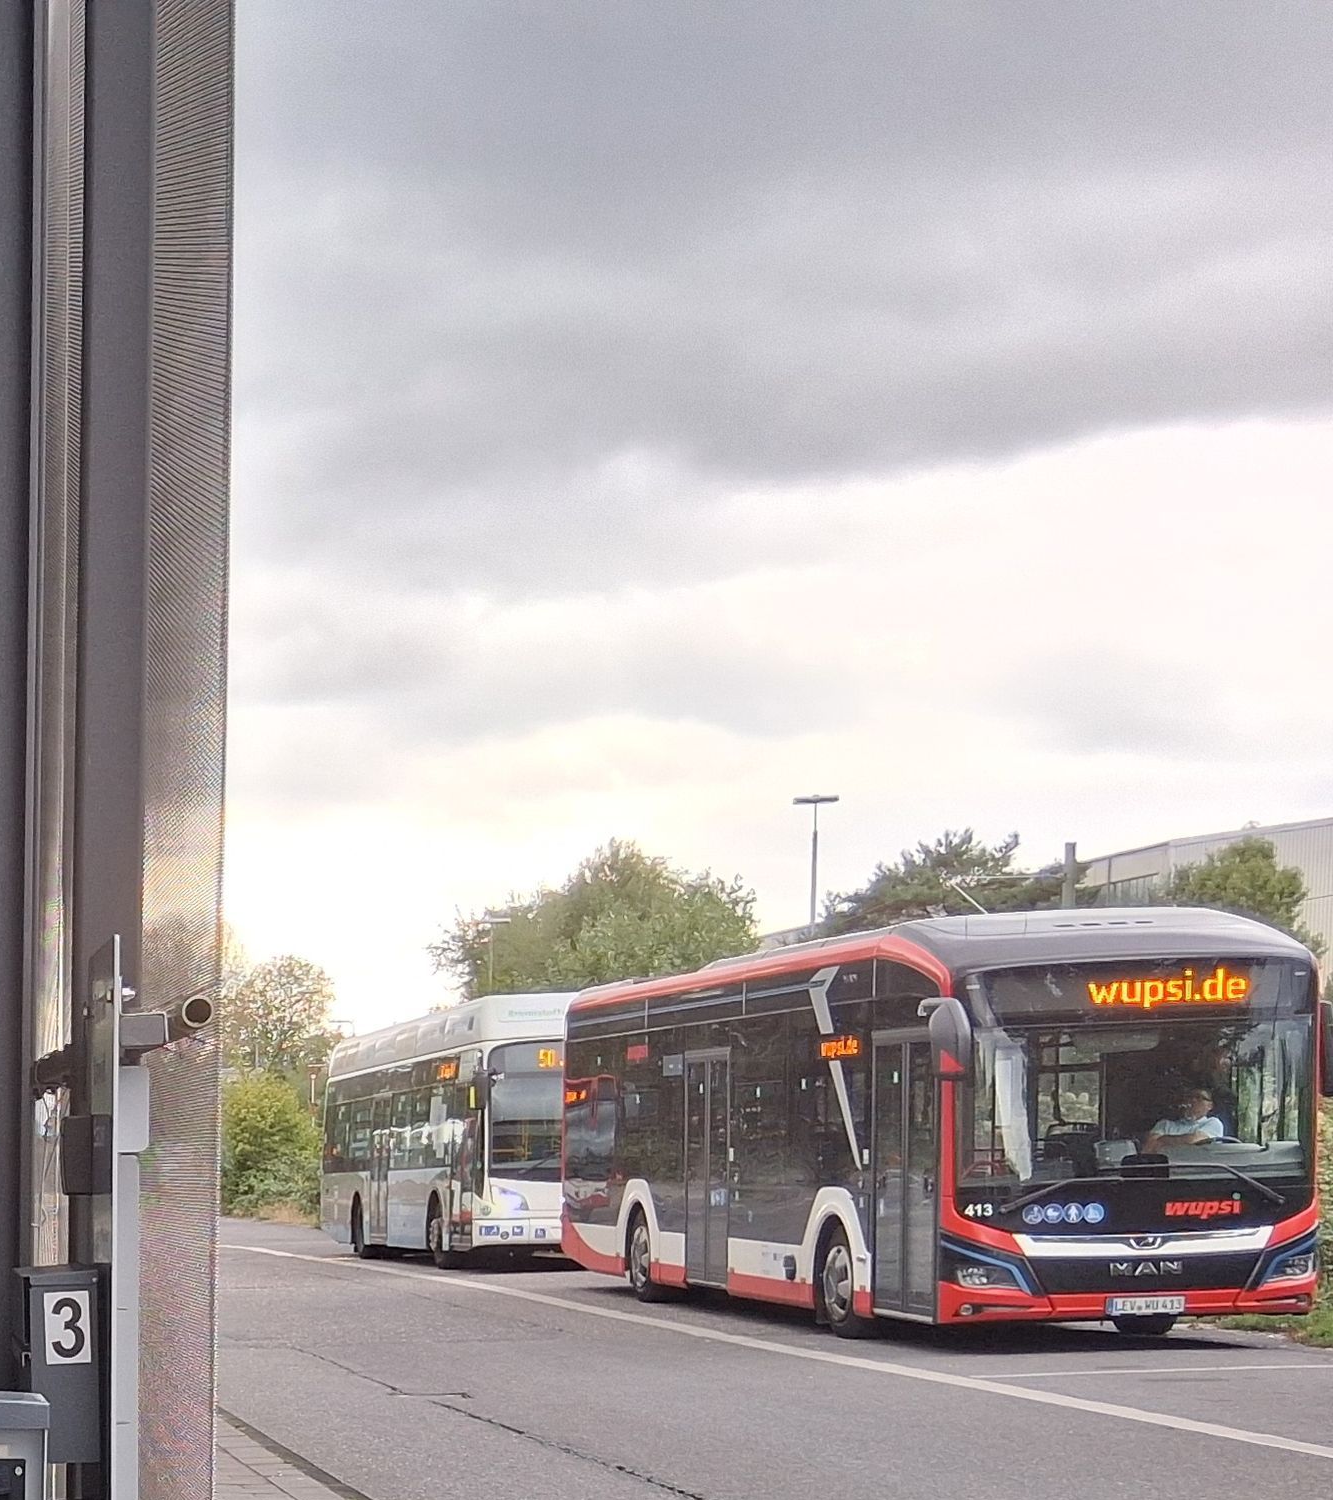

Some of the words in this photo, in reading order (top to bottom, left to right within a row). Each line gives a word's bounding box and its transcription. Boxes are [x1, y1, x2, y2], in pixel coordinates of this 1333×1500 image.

[1088, 968, 1247, 1008] wupsi.de
[964, 1203, 993, 1217] 413
[1165, 1192, 1241, 1220] wupsi
[1109, 1261, 1182, 1277] MAN
[50, 1297, 86, 1359] 3
